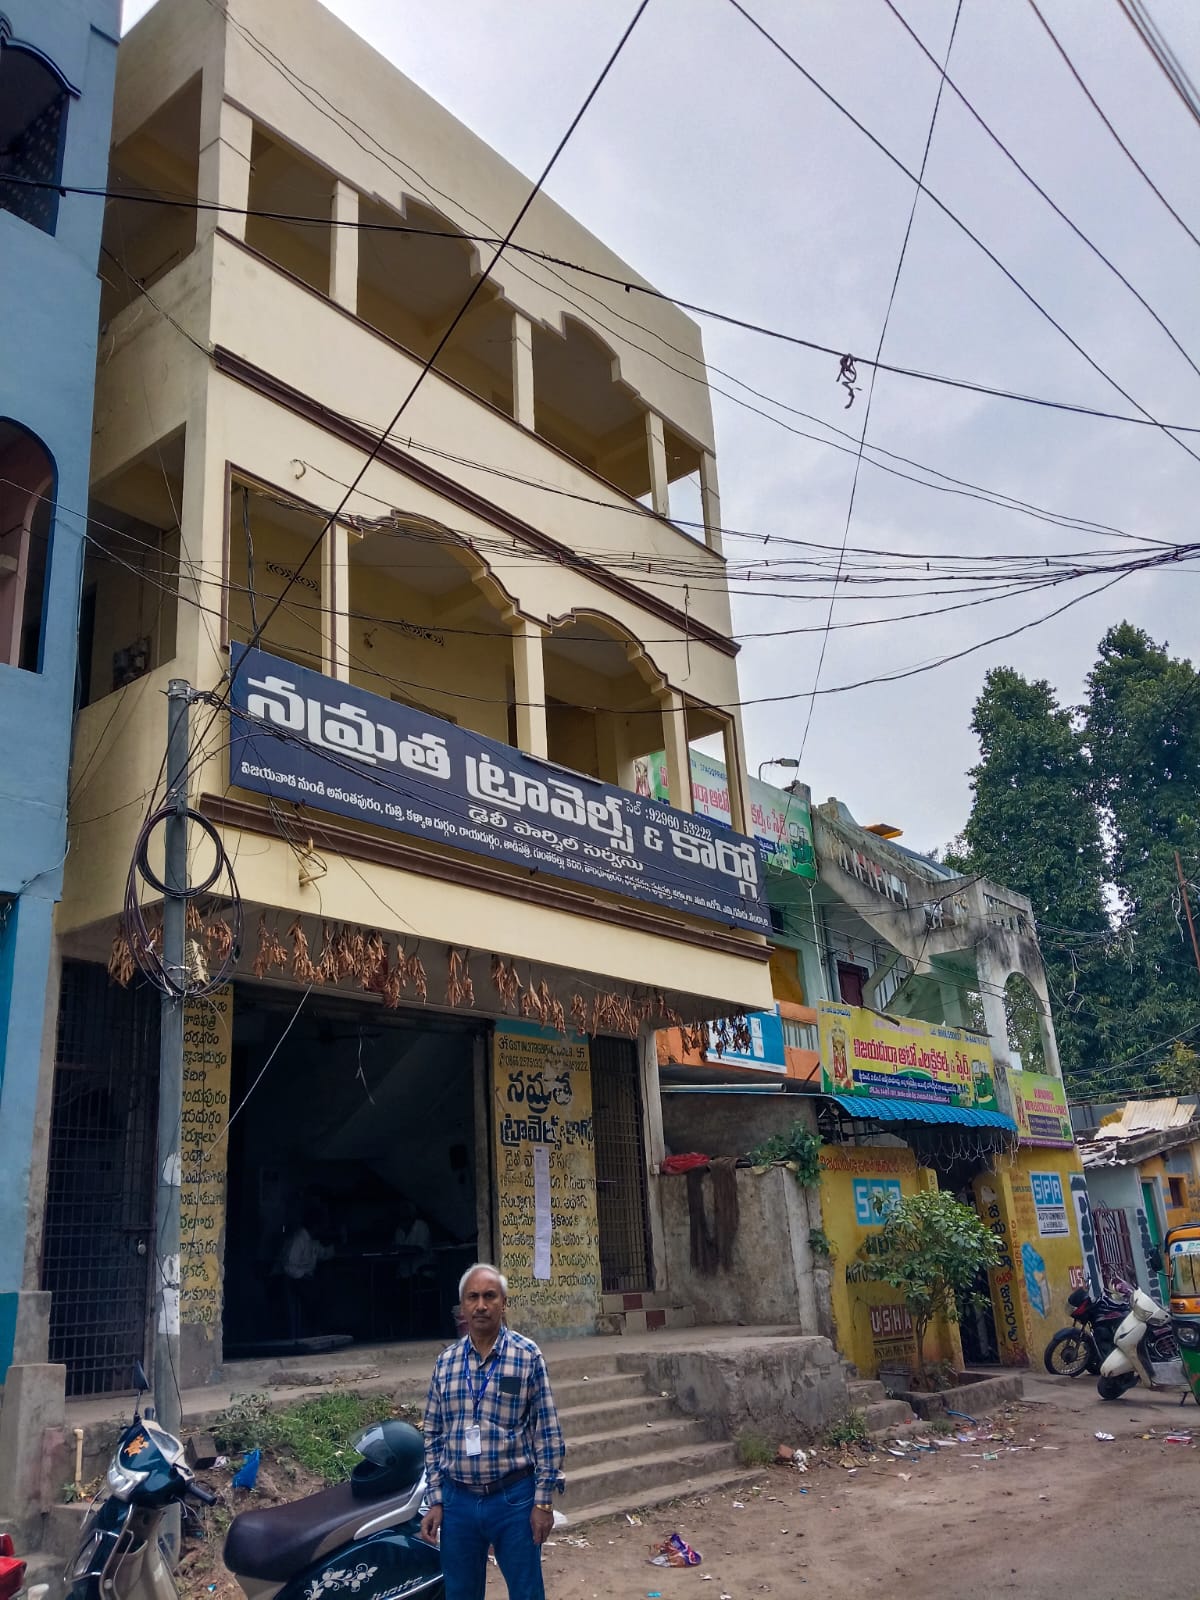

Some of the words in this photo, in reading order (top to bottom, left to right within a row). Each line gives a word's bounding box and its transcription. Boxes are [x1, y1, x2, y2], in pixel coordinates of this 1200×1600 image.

[241, 761, 297, 788] విజయవాడ
[297, 777, 325, 796] నుండి
[247, 675, 451, 780] నమ్రత
[464, 752, 635, 855] ట్రావెల్స్
[644, 825, 664, 852] &
[669, 828, 760, 902] కార్గో
[683, 820, 712, 842] 53222
[1033, 1179, 1063, 1204] SPA
